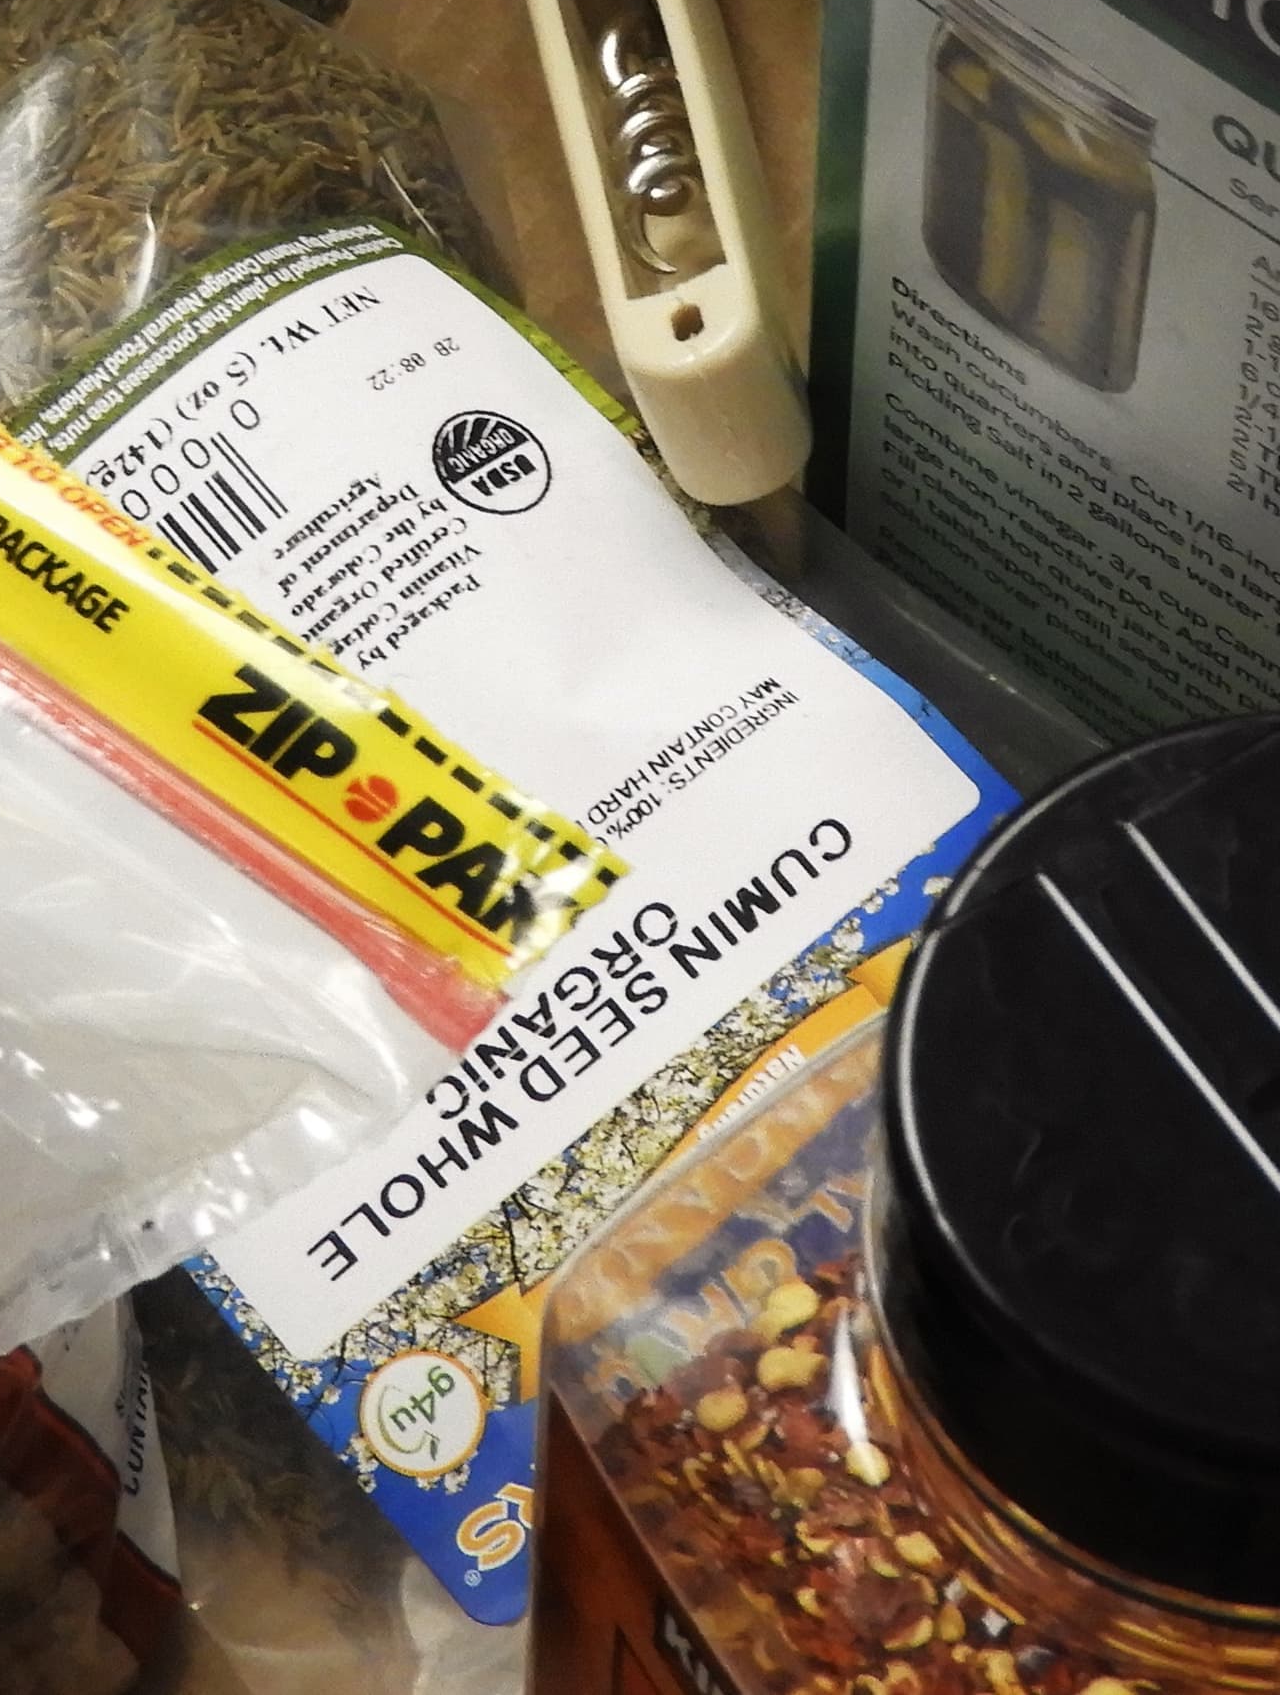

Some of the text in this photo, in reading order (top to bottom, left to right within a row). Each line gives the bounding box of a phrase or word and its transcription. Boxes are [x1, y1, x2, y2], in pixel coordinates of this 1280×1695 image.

[190, 245, 260, 309] Cottage
[314, 273, 383, 338] NET
[1246, 288, 1280, 327] 16
[136, 285, 206, 349] Natural
[189, 297, 233, 339] that
[257, 308, 320, 367] Wt.
[890, 274, 1027, 387] Directions
[1243, 311, 1264, 341] 2
[96, 333, 147, 379] Food
[111, 320, 203, 400] processes
[220, 348, 263, 390] (5
[1238, 357, 1259, 387] 6
[35, 365, 109, 432] Markets,
[83, 386, 125, 425] tree
[171, 374, 228, 427] oz)
[1236, 380, 1280, 427] 1/4
[44, 412, 93, 457] nuts,
[444, 416, 516, 483] ORGANIC
[1228, 446, 1248, 475] 5
[1231, 425, 1251, 453] 2
[11, 446, 63, 491] TO
[56, 478, 151, 553] OPEN
[468, 443, 538, 508] USDA
[1226, 469, 1256, 504] 21
[268, 467, 386, 567] Agriculture
[272, 475, 420, 599] Department of
[377, 508, 470, 589] Certified
[286, 491, 447, 624] by the Colorado
[325, 535, 483, 663] Vitamin Cottag
[351, 564, 482, 676] Packaged by
[195, 655, 364, 803] ZIP
[583, 671, 782, 828] MAY CONTAIN HARD
[658, 681, 799, 801] INGREDIENTS:
[601, 788, 665, 845] 100%
[663, 810, 862, 982] CUMIN
[414, 893, 689, 1126] ORGANIC
[508, 964, 675, 1110] SEED
[301, 1096, 519, 1284] WHOLE
[388, 1364, 456, 1434] g4u
